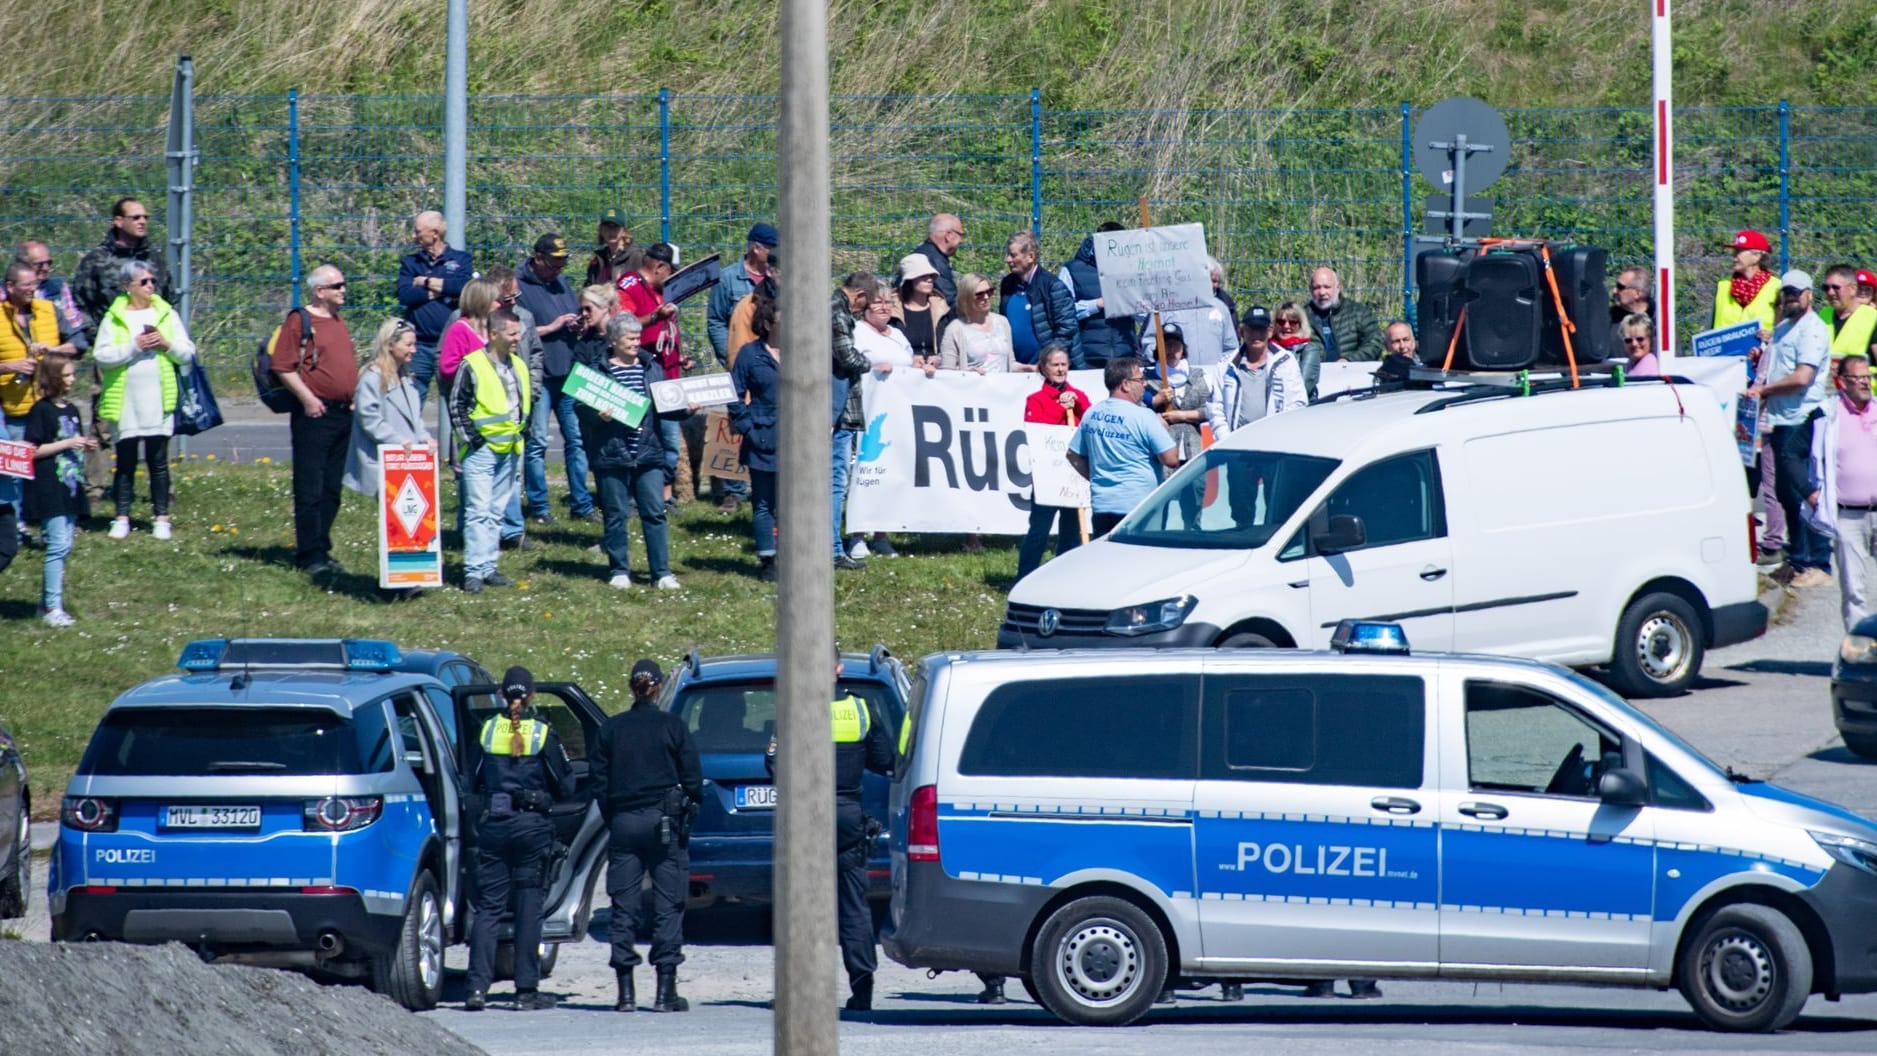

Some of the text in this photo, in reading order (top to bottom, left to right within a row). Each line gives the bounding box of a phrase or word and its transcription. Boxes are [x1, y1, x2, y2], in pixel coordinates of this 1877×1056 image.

[830, 709, 857, 721] LIZEI
[747, 787, 778, 805] RÜG
[169, 808, 258, 825] MVL 33120
[96, 849, 156, 864] POLIZEI
[1237, 842, 1387, 877] POLIZEI
